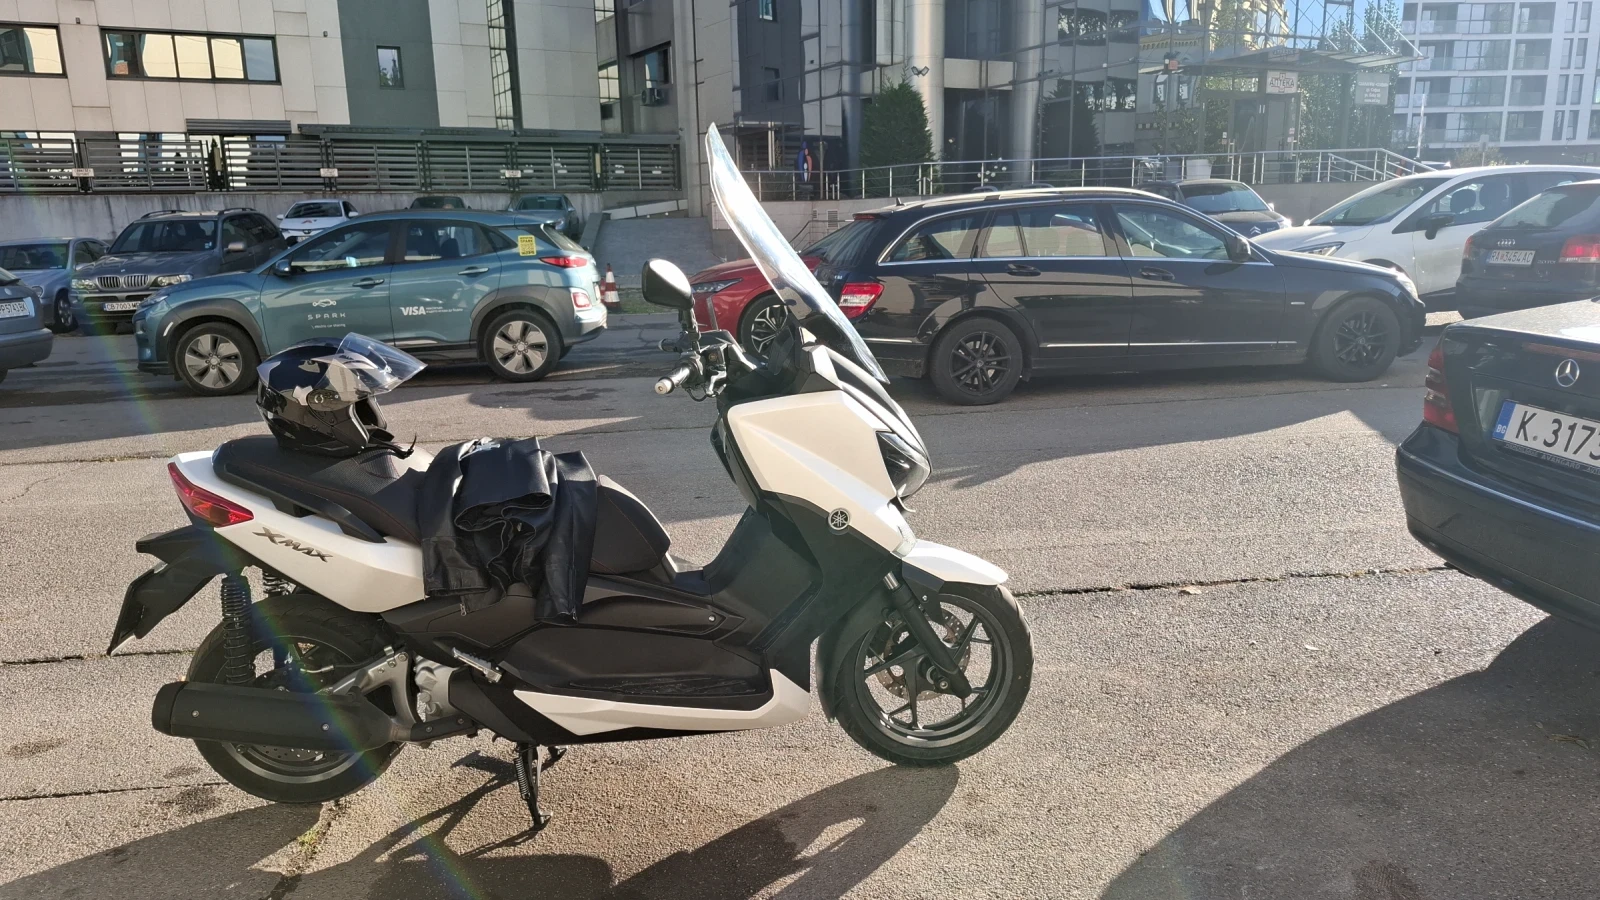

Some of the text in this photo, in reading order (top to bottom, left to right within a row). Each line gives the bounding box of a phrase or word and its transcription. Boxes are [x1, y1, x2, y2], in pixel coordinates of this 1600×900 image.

[1270, 79, 1295, 87] АПТЕКА
[400, 306, 426, 316] VISA
[307, 312, 346, 321] SPARK
[1496, 424, 1507, 434] BG
